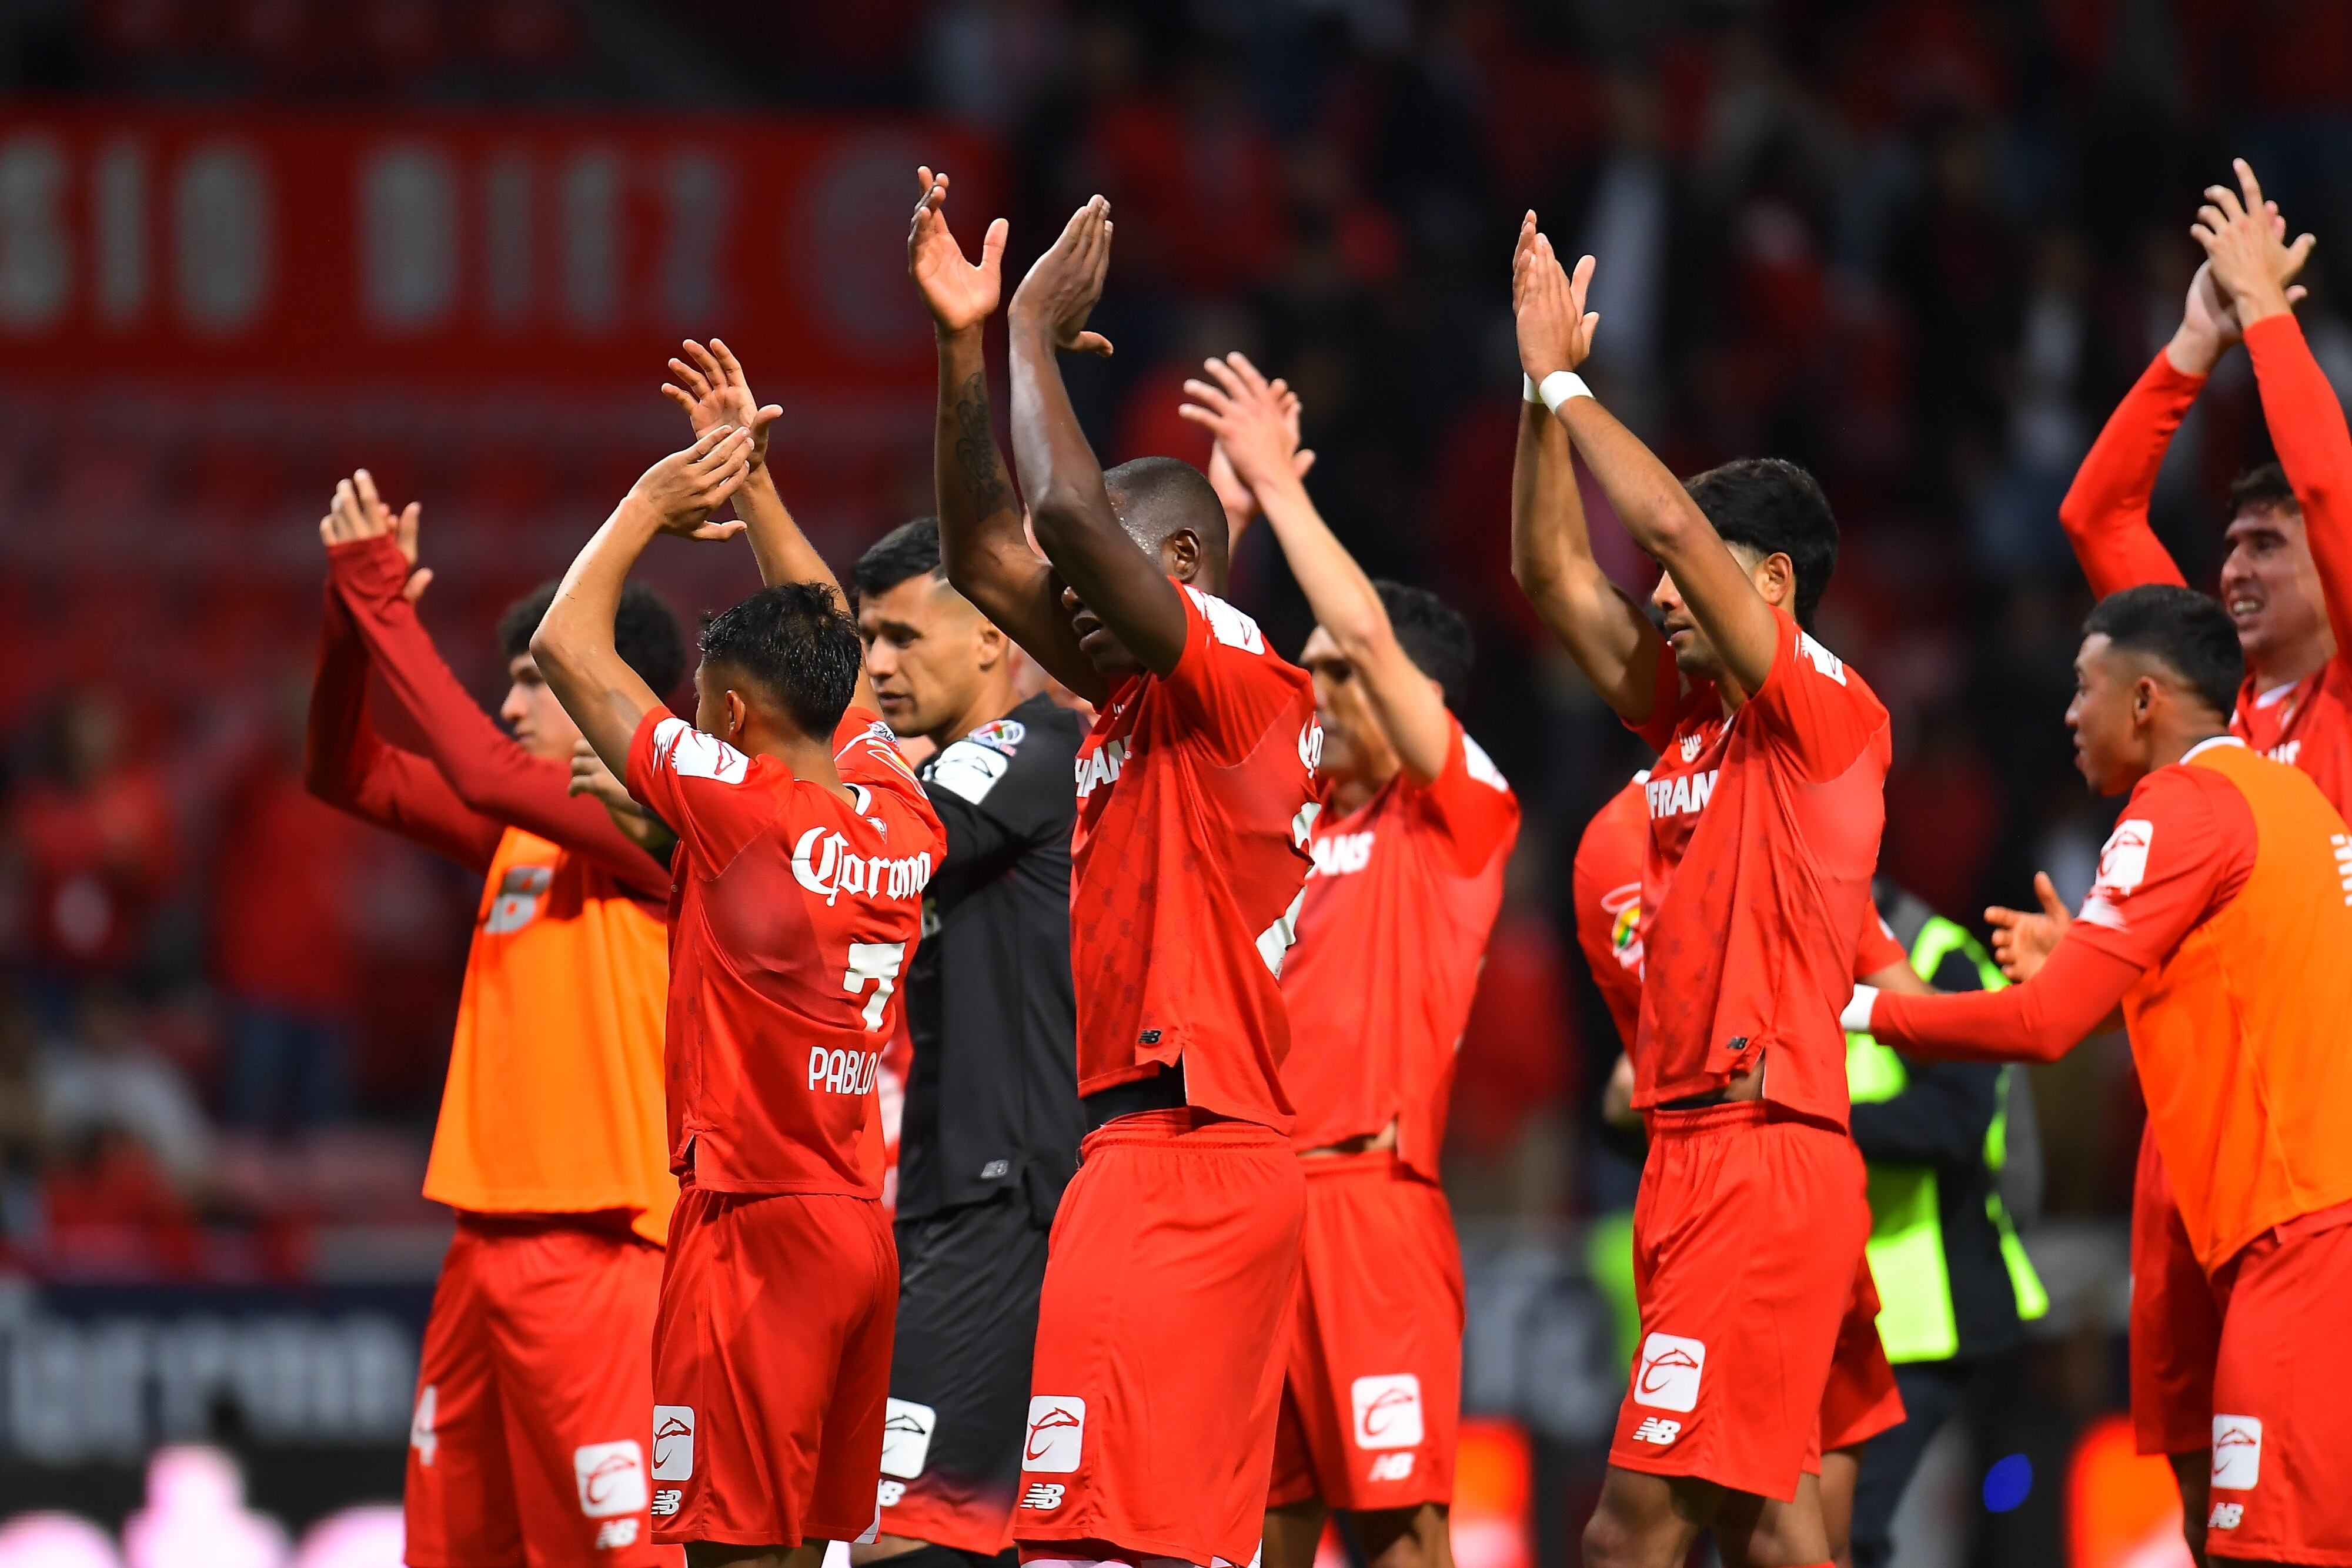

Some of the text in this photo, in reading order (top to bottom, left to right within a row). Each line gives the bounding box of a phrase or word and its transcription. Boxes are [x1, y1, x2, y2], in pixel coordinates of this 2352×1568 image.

[1646, 769, 1719, 820] FRAN
[790, 826, 931, 907] Corona
[843, 942, 906, 1033] 7
[413, 1384, 438, 1466] 4
